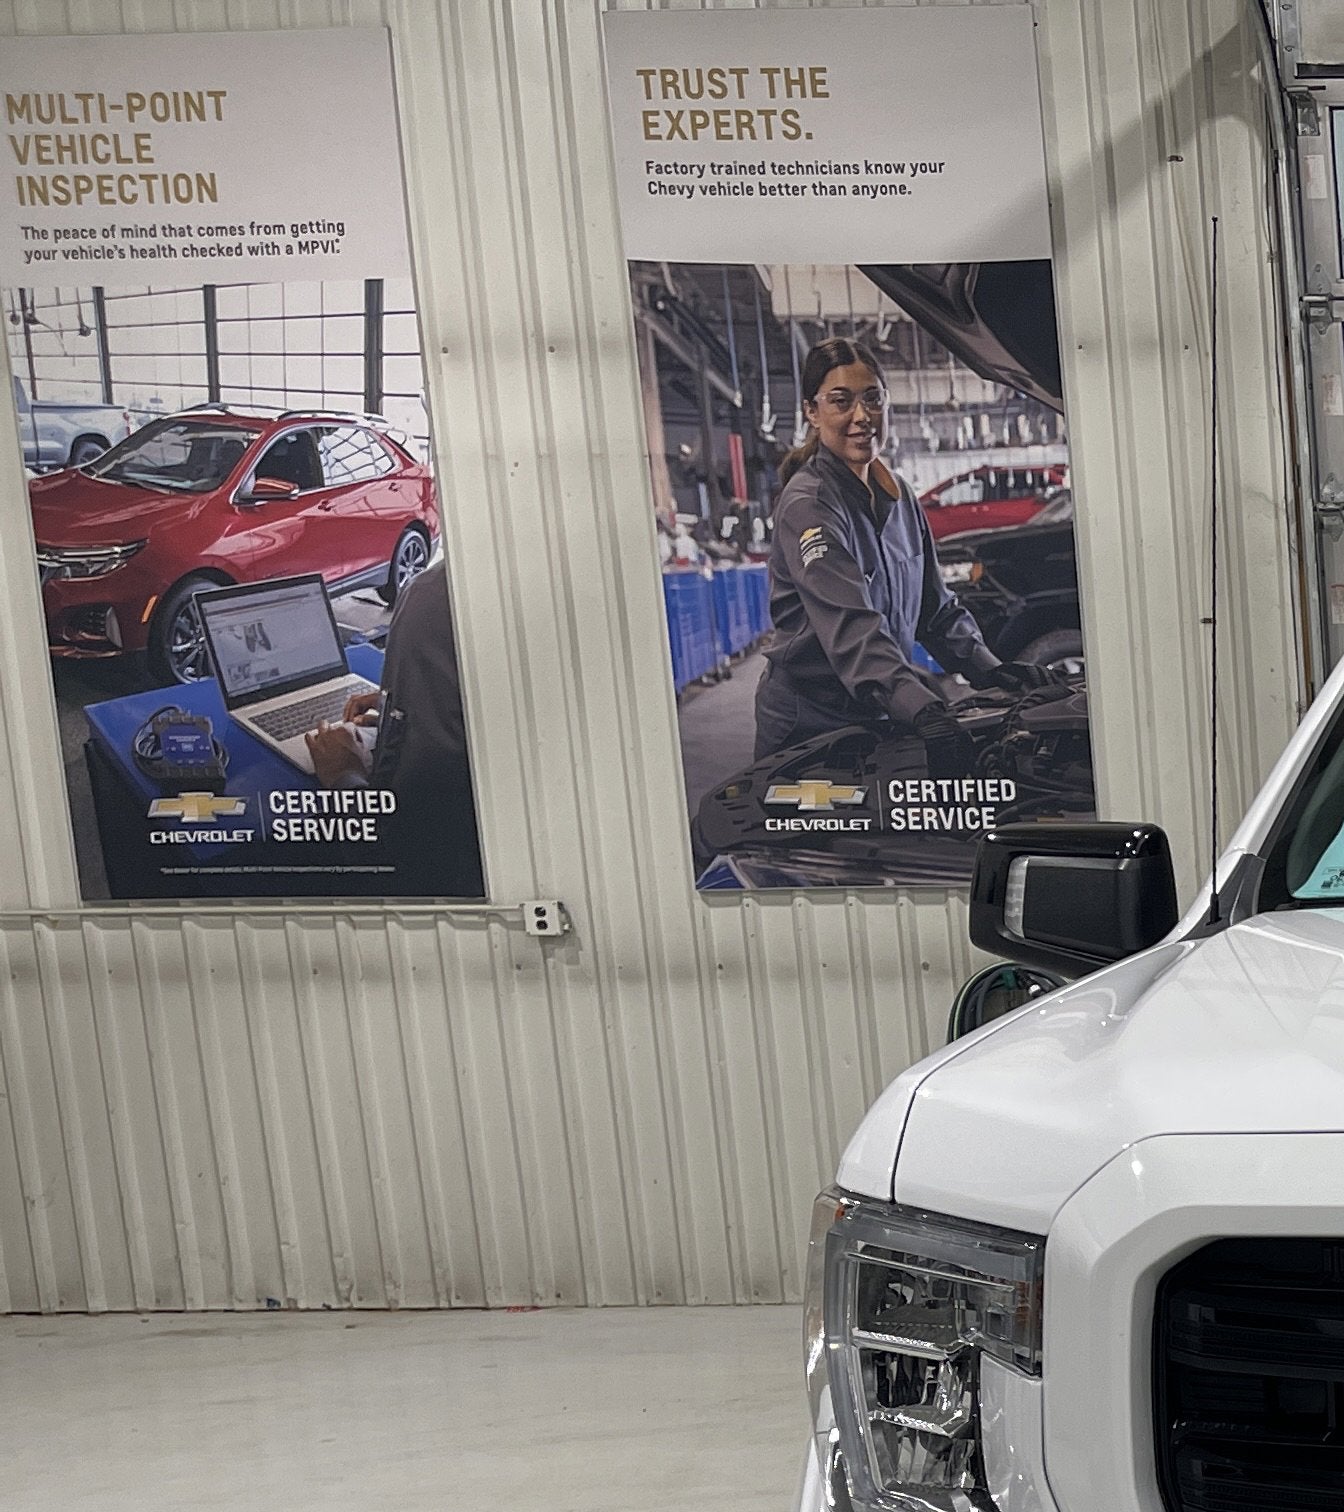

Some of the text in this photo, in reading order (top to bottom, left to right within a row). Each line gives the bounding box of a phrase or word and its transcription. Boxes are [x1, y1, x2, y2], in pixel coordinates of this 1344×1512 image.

[635, 66, 830, 101] TRUST THE
[4, 90, 227, 125] MULTI-POINT
[642, 108, 814, 141] EXPERTS.
[7, 132, 155, 166] VEHICLE
[645, 159, 945, 179] Factory trained technicians know your
[15, 172, 218, 207] INSPECTION
[647, 180, 912, 200] Chevy vehicle better than anyone.
[20, 218, 345, 244] The peace of mind that comes from getting
[23, 249, 58, 265] your
[61, 244, 126, 260] vehicle's
[129, 244, 178, 259] health
[181, 242, 243, 258] checked
[246, 241, 281, 257] with
[285, 244, 295, 255] a
[269, 790, 396, 814] CERTIFIED
[888, 779, 1016, 803] CERTIFIED
[272, 817, 378, 842] SERVICE
[765, 818, 872, 831] CHEVROLET
[890, 806, 997, 831] SERVICE
[149, 829, 255, 844] CHEVROLET
